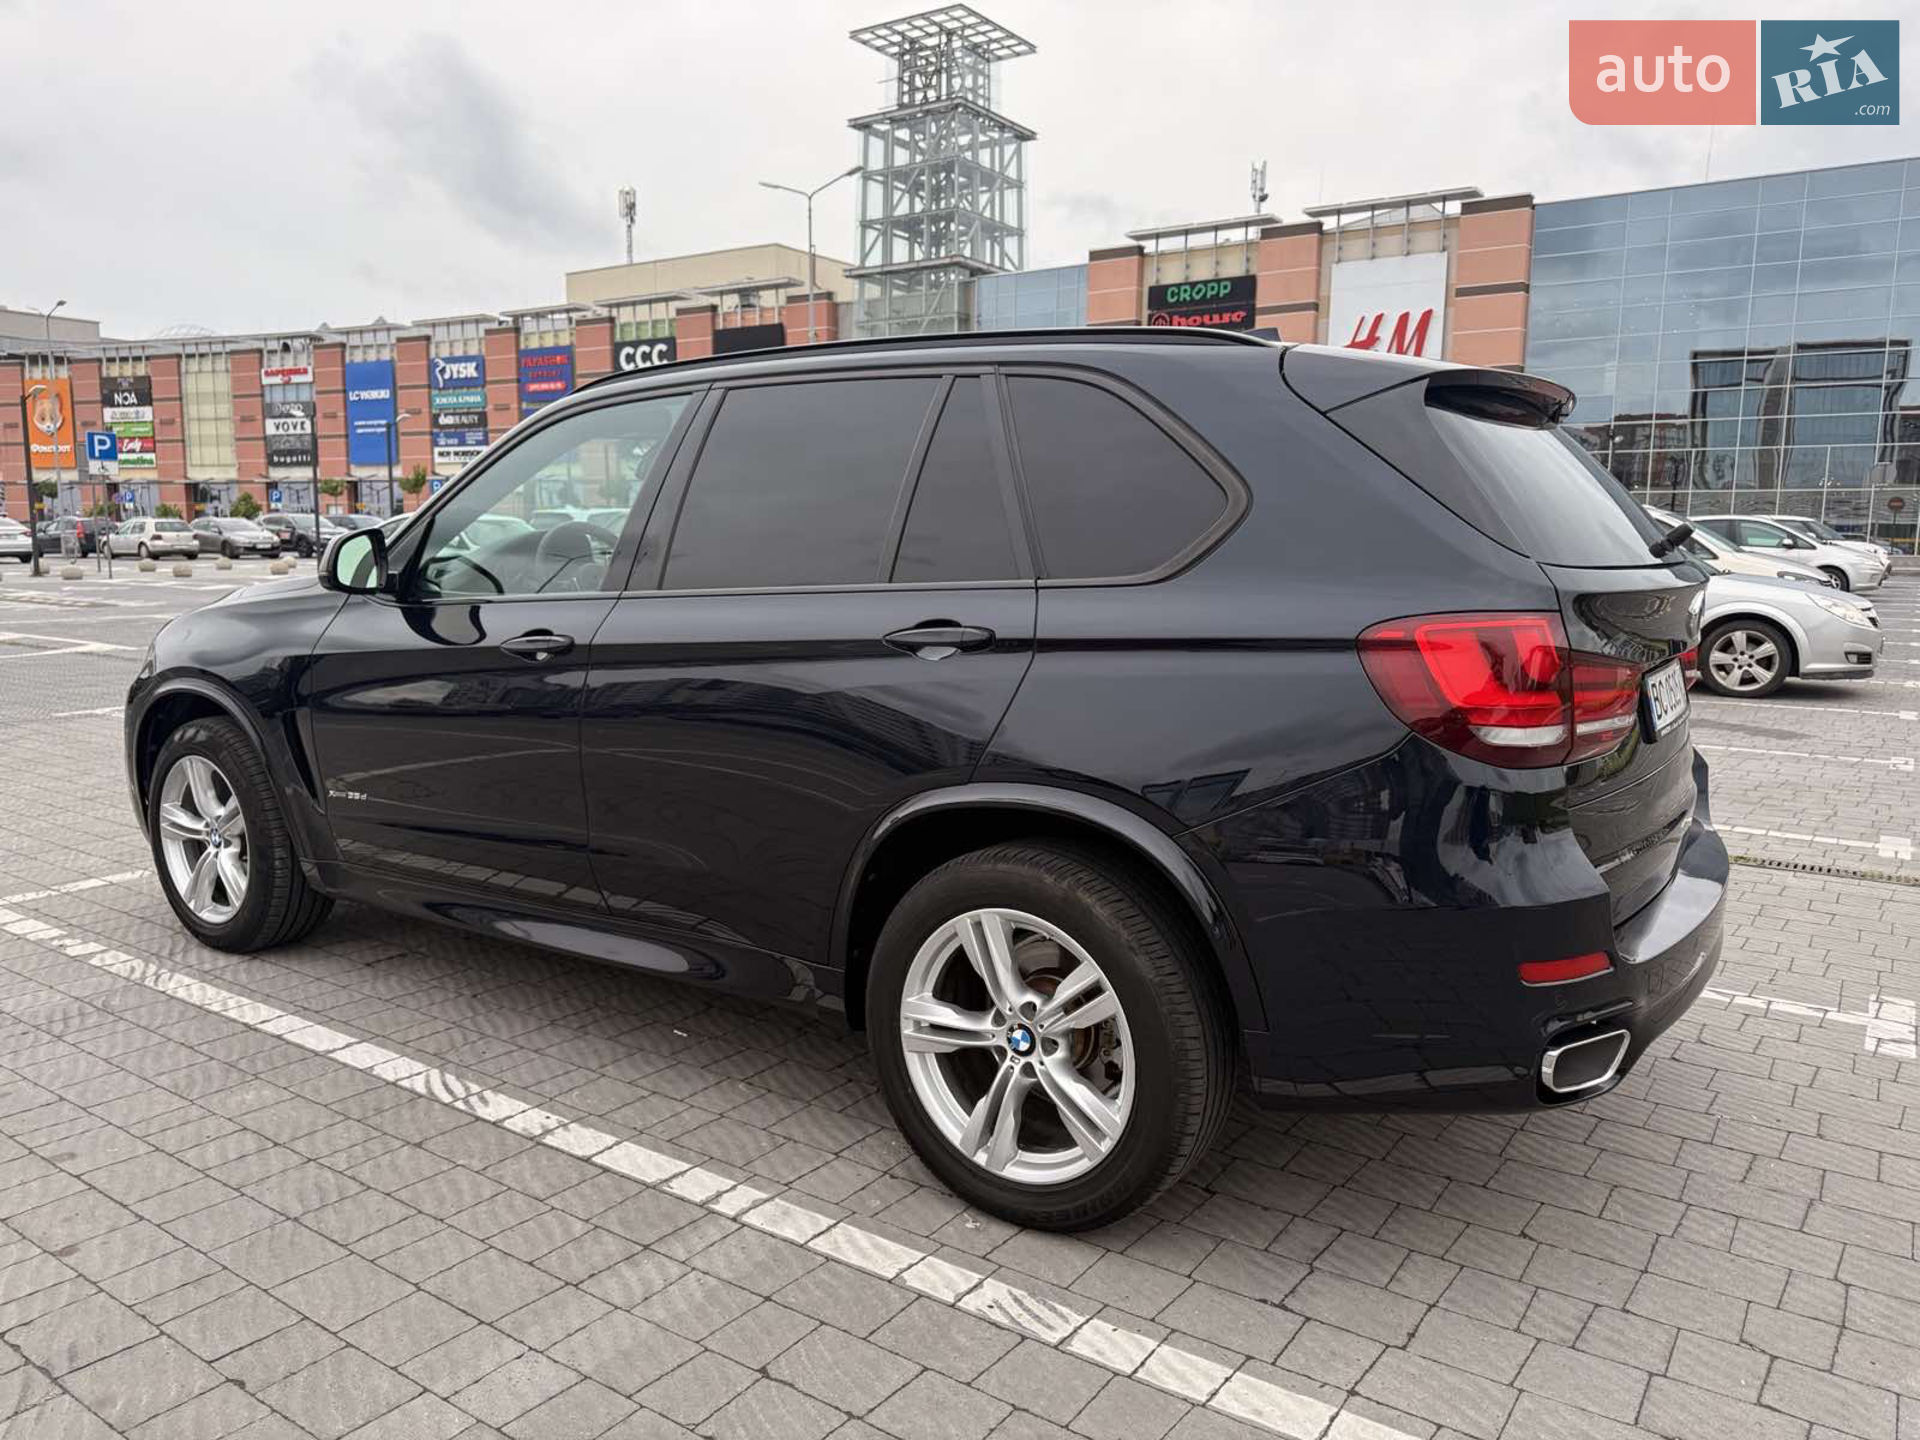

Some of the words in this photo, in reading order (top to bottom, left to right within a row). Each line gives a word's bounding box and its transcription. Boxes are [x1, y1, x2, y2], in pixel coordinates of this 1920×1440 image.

[1167, 281, 1231, 302] CROPP
[1171, 310, 1247, 327] house
[619, 344, 668, 372] CCC
[443, 362, 479, 379] JYSK
[273, 420, 307, 433] VOVK
[93, 434, 111, 457] P
